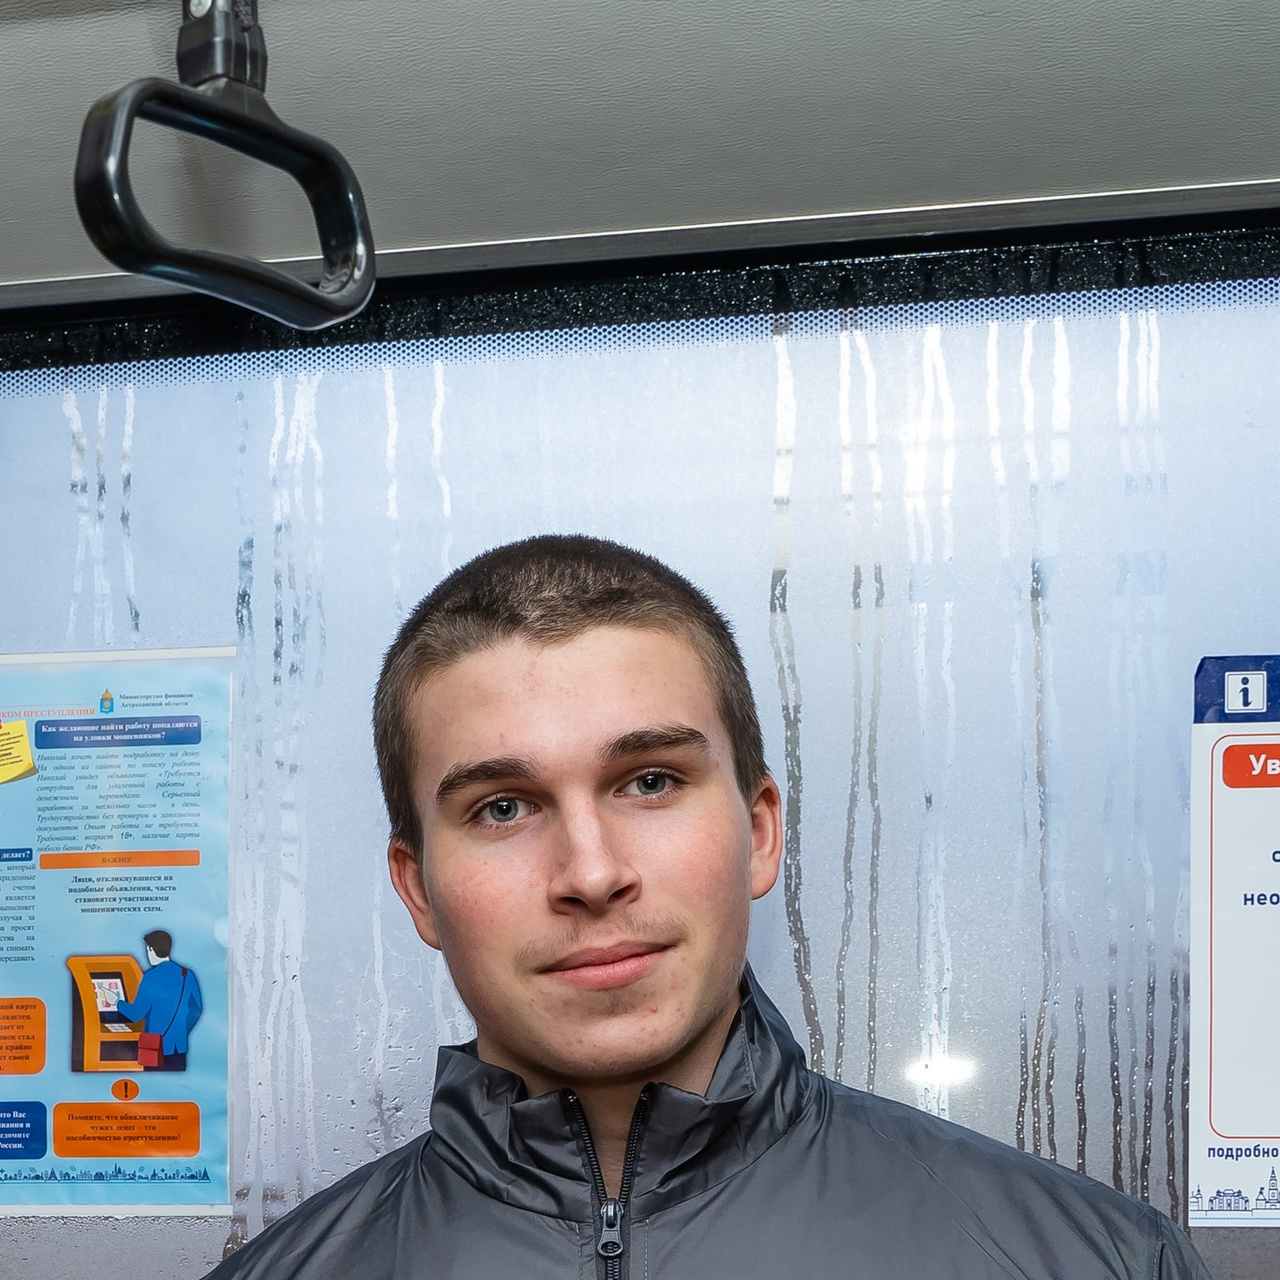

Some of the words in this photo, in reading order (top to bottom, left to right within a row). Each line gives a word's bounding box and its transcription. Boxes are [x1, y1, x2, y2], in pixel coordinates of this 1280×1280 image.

[24, 709, 95, 717] ПРЕСТУПЛЕНИЯ
[101, 723, 123, 731] найти
[126, 722, 150, 731] работу
[153, 721, 197, 729] попадаются
[85, 735, 111, 743] уловки
[114, 732, 165, 740] мошенников?
[156, 781, 185, 789] работы
[120, 832, 135, 840] 18+,
[96, 875, 161, 883] откликнувшиеся
[123, 1134, 180, 1142] преступлению!
